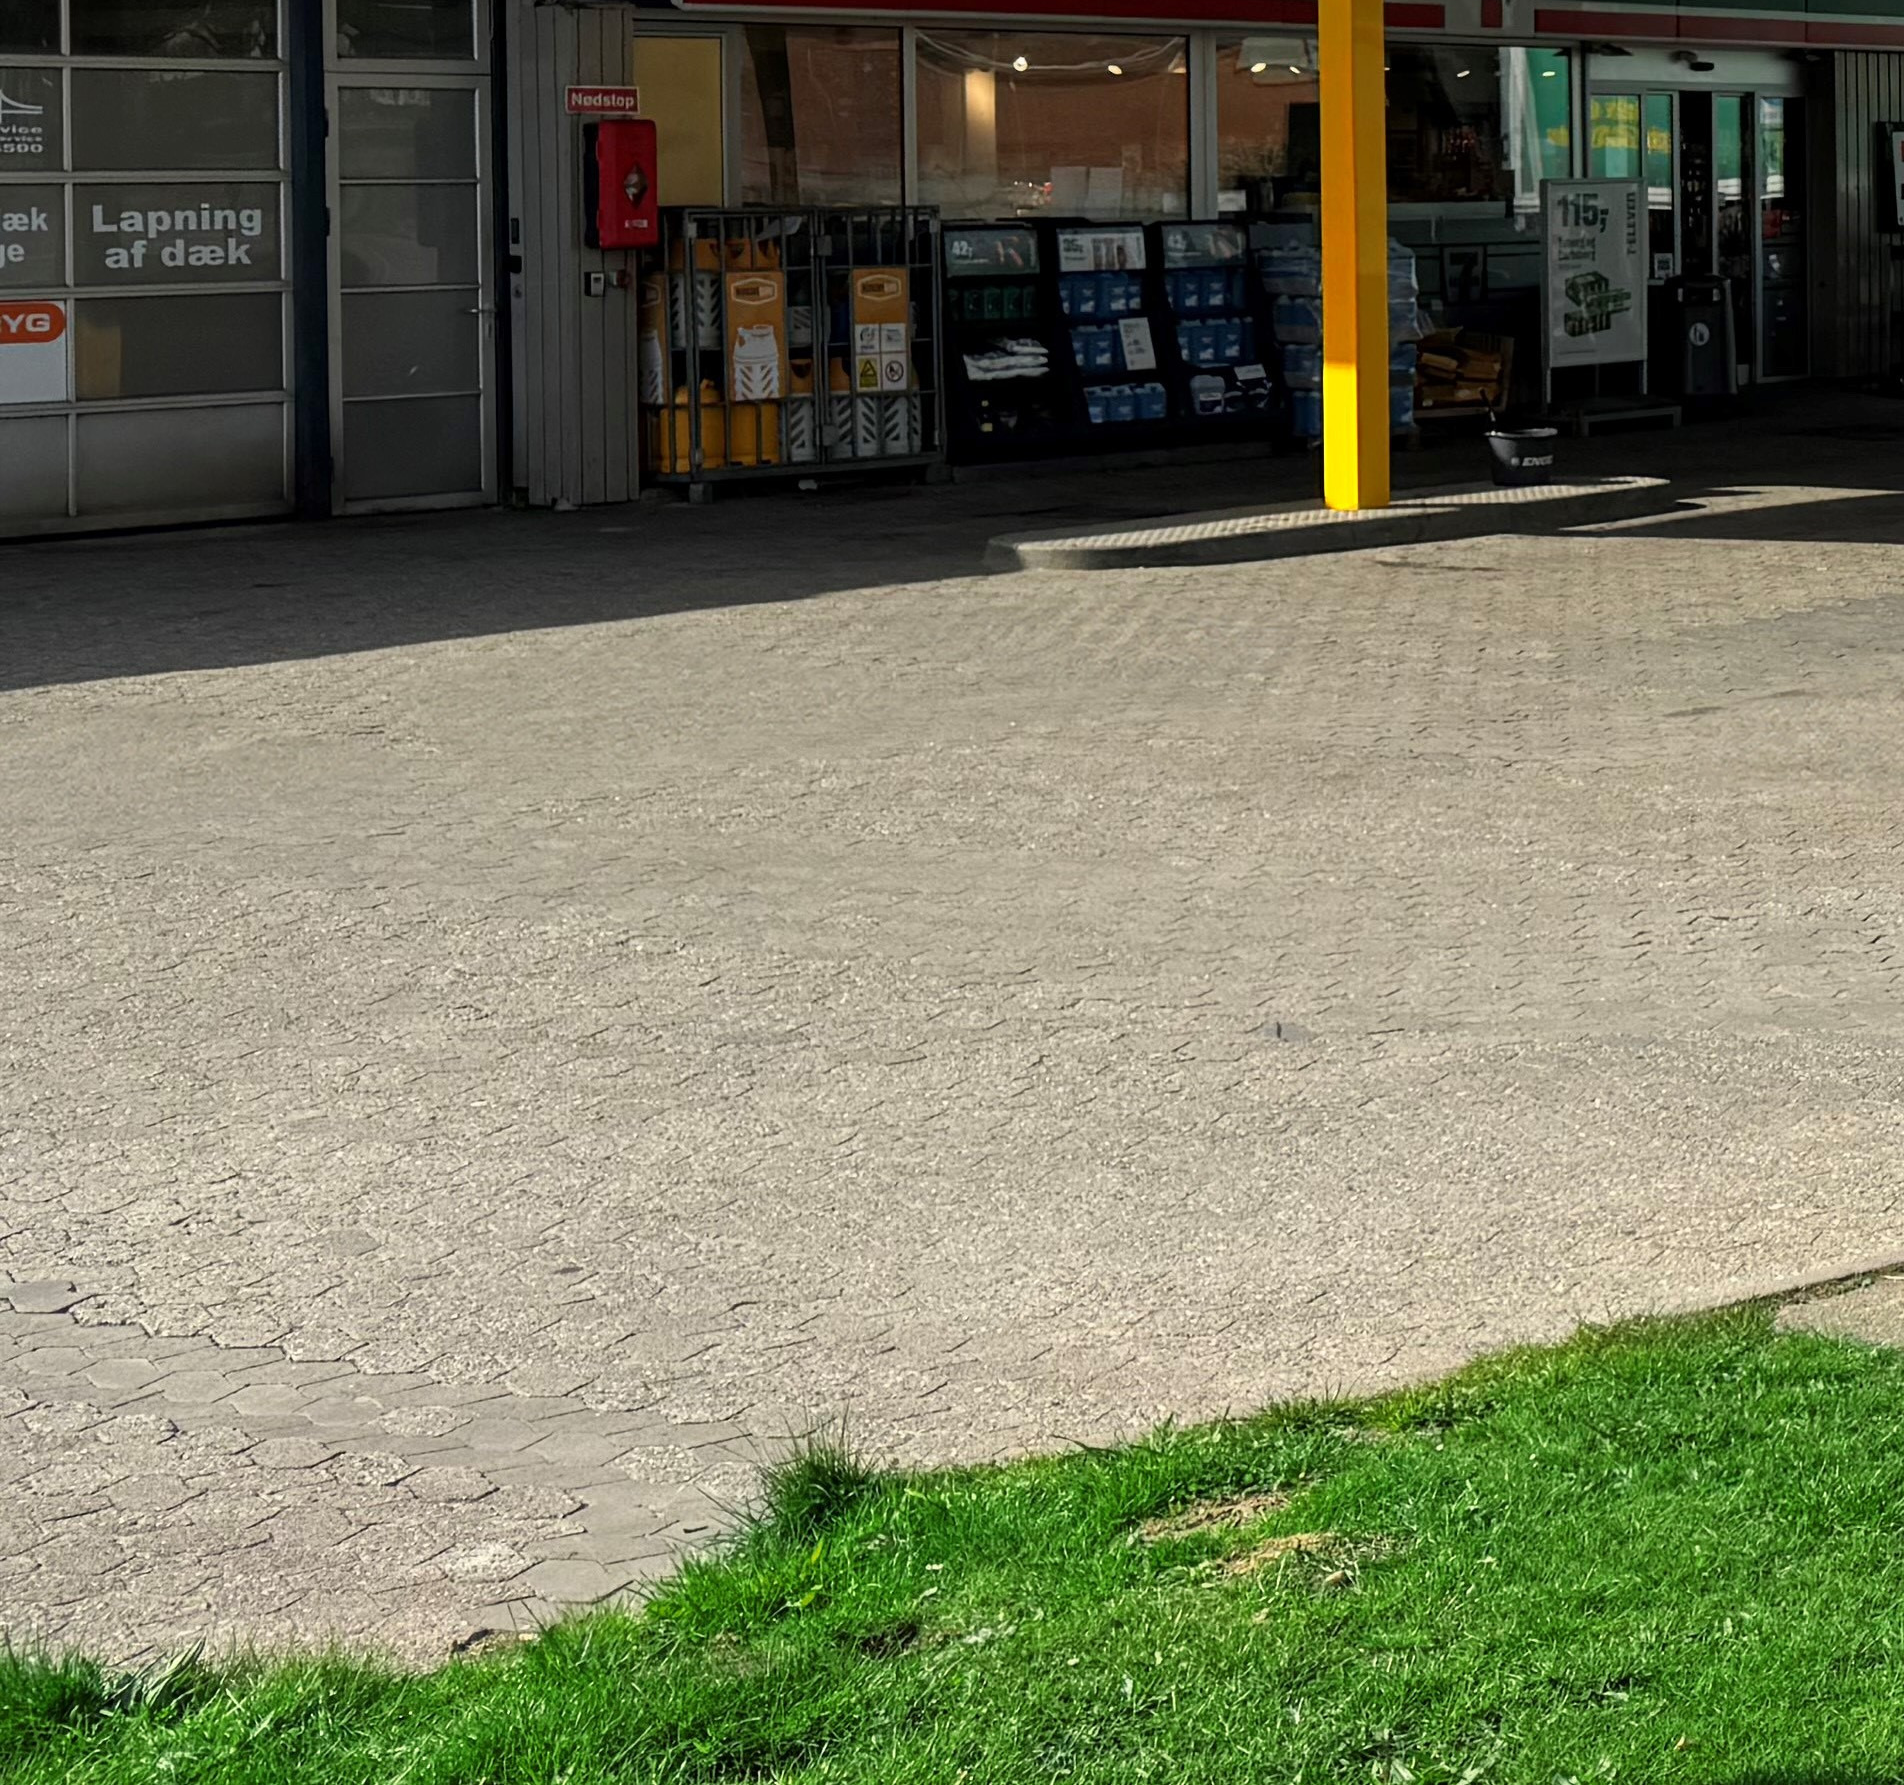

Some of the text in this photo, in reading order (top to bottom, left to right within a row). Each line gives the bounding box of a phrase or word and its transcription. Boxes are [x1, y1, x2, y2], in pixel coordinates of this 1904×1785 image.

[571, 92, 635, 109] Nødstop
[92, 202, 262, 239] Lapning
[105, 237, 251, 268] af dæk
[0, 313, 50, 334] YG
